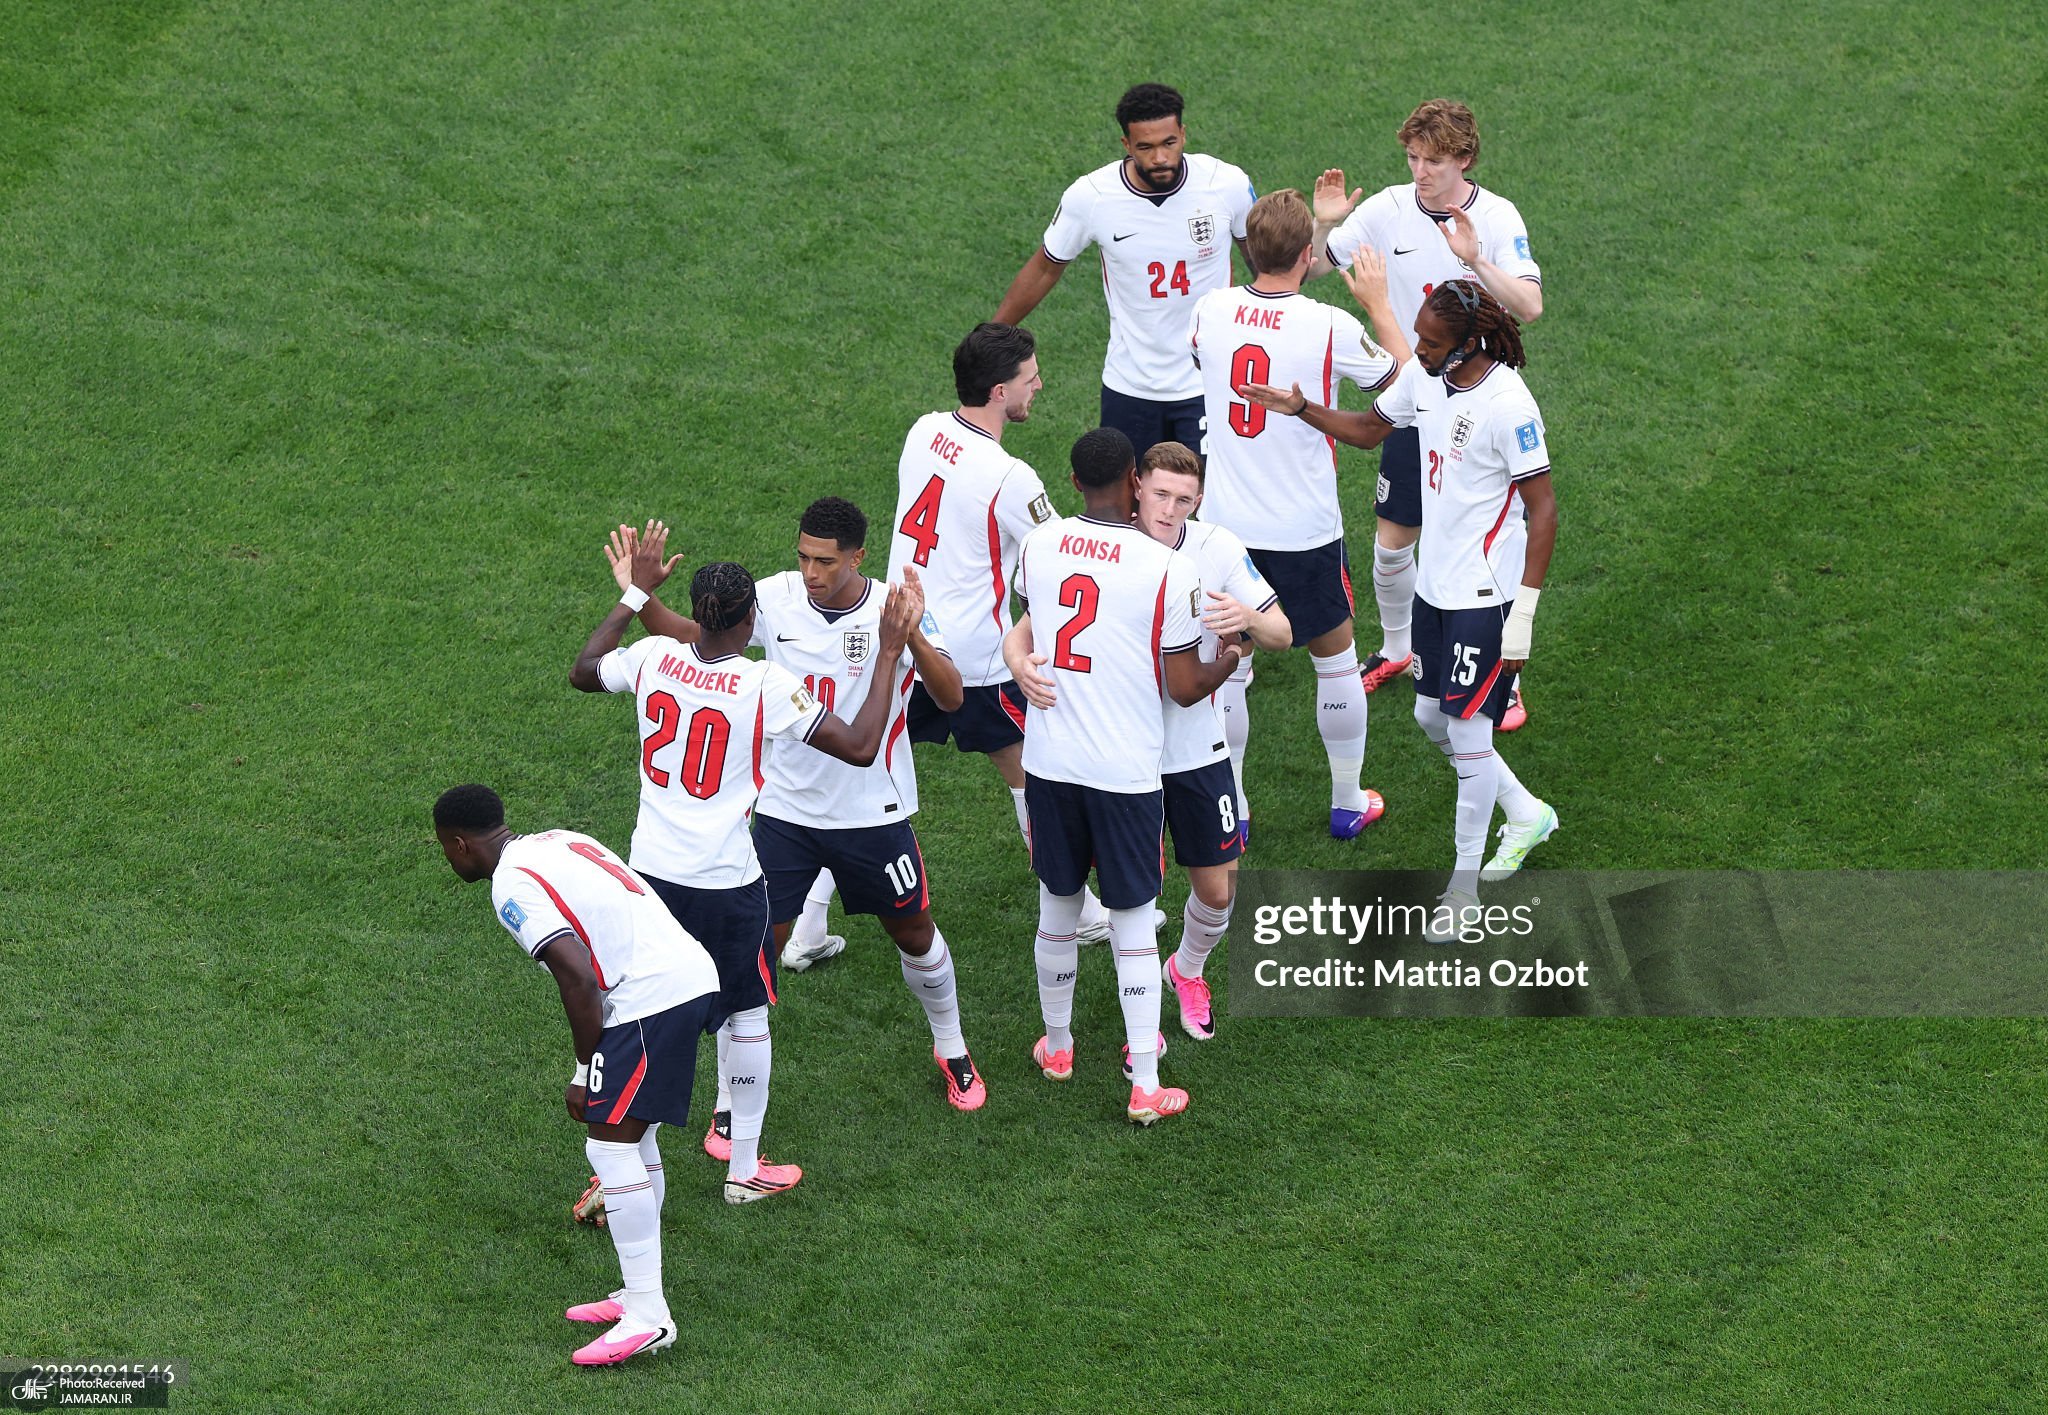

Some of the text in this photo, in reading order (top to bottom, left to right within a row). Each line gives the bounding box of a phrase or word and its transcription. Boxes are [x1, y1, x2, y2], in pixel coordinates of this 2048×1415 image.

[1147, 260, 1190, 298] 24
[1234, 305, 1284, 330] KANE
[1229, 343, 1270, 438] 9
[930, 432, 964, 466] RICE
[899, 474, 945, 568] 4
[1059, 534, 1122, 564] KONSA
[1053, 573, 1100, 674] 2
[657, 653, 741, 696] MADUEKE
[1450, 642, 1481, 686] 25
[1323, 702, 1347, 710] ENG
[643, 690, 731, 800] 20
[1218, 794, 1235, 833] 8
[566, 842, 646, 897] 6
[884, 853, 918, 896] 10
[1056, 970, 1076, 982] ENG
[1123, 986, 1146, 996] ENG
[589, 1052, 605, 1093] 6
[731, 1076, 756, 1085] ENG
